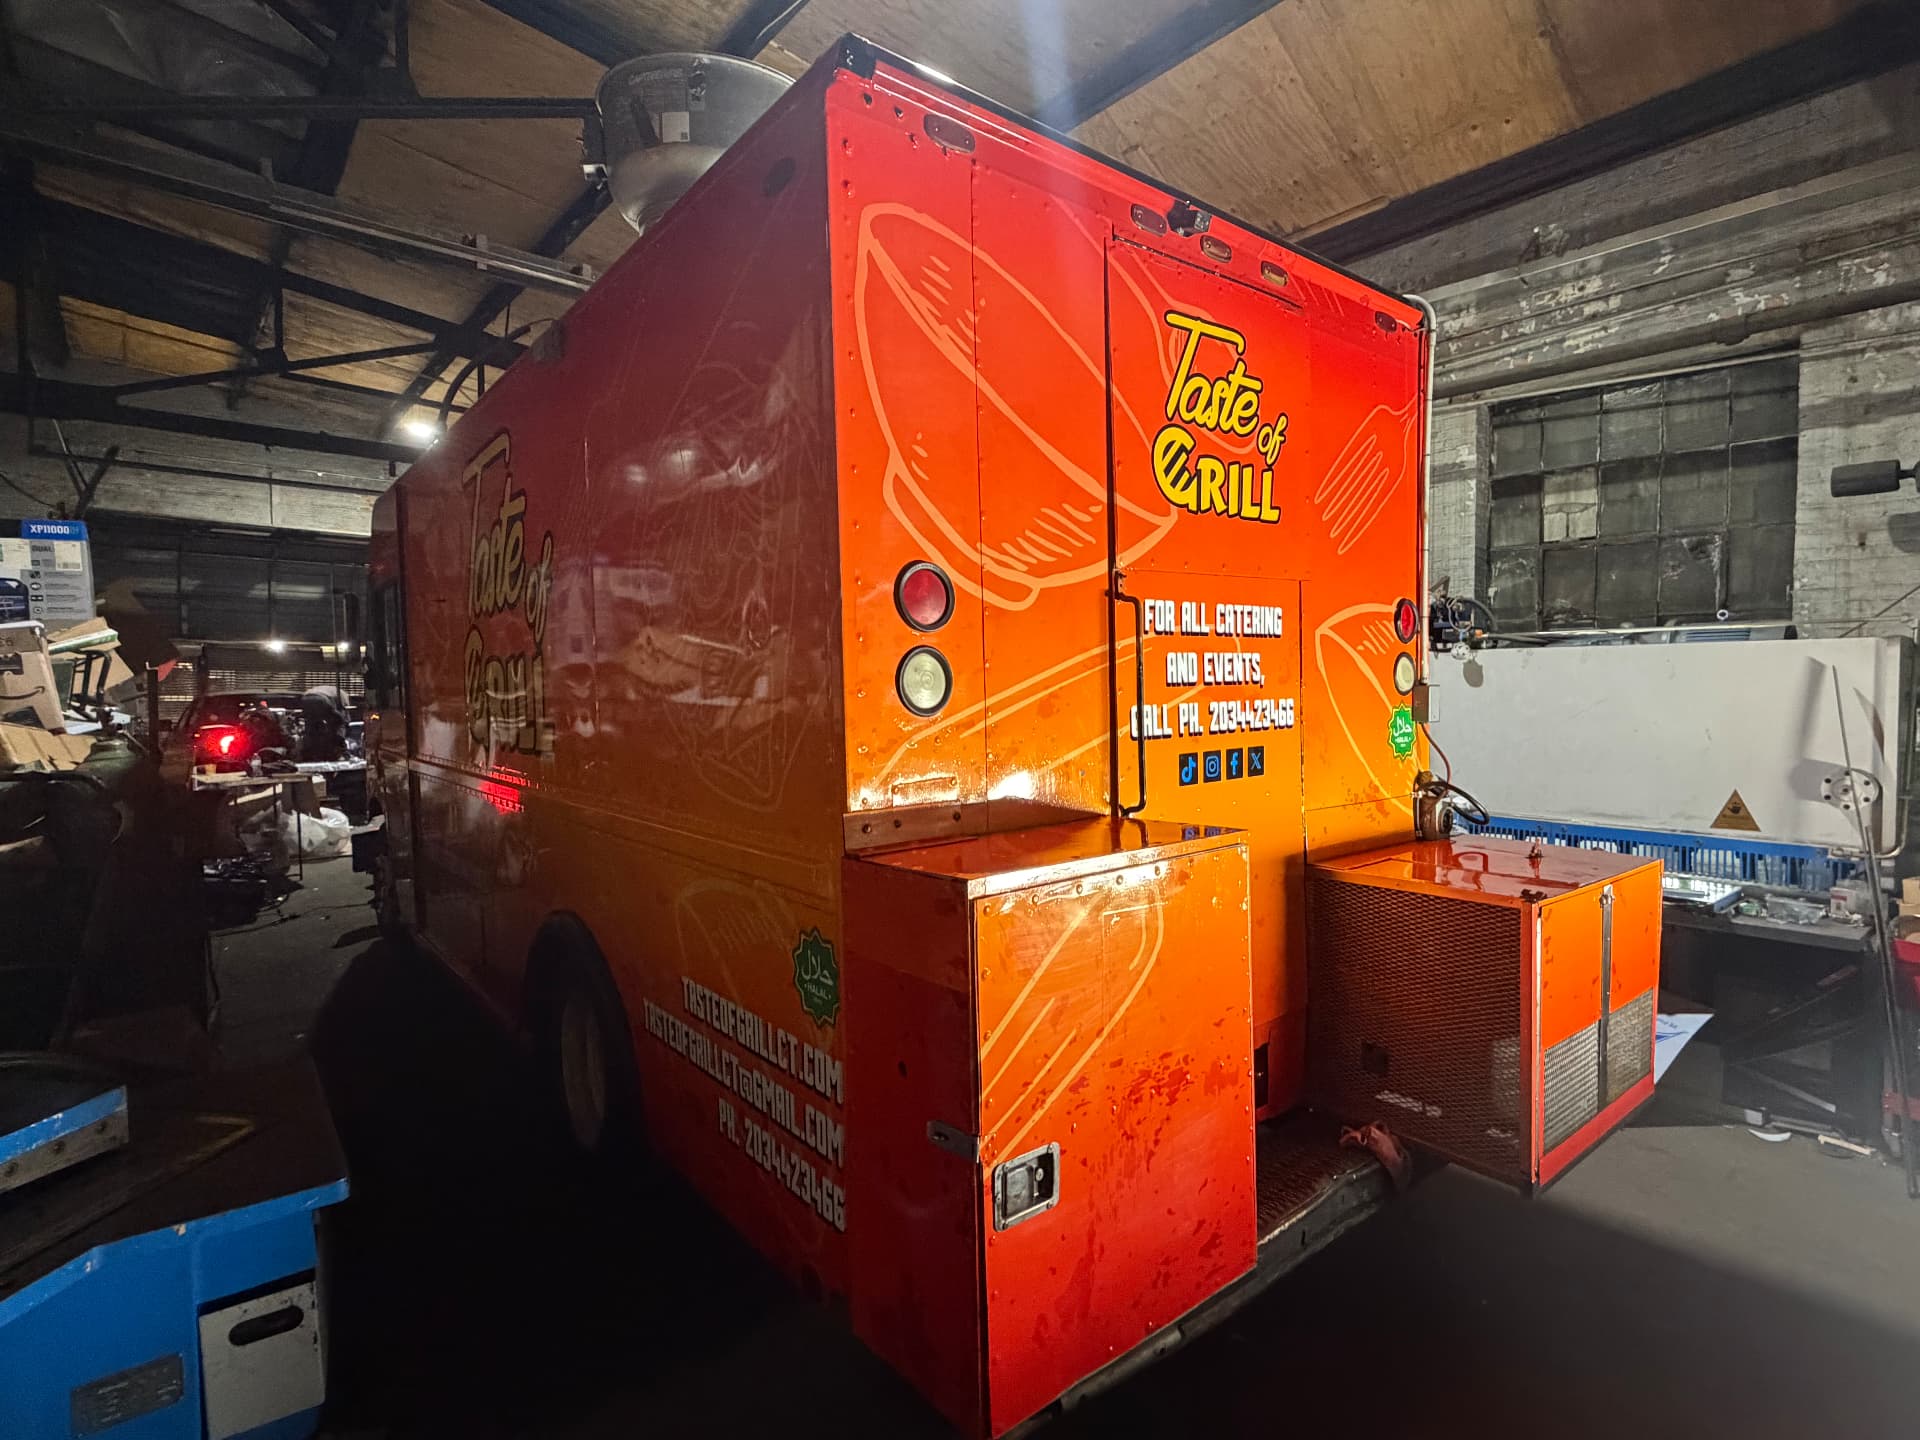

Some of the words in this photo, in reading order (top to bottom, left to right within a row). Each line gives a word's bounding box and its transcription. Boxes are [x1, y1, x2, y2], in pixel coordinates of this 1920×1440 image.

[1165, 310, 1263, 436] Taste
[1153, 424, 1281, 524] GRILL
[1257, 413, 1288, 466] of
[462, 428, 527, 620] Taste
[526, 530, 552, 652] of
[1144, 599, 1175, 634] FOR
[1181, 602, 1210, 635] ALL
[1215, 603, 1282, 638] CATERING
[1130, 703, 1173, 740] CALL
[1179, 702, 1204, 737] PH.
[1208, 698, 1294, 734] 2034423466
[1166, 652, 1198, 687] AND
[1203, 652, 1265, 688] EVENTS,
[801, 949, 834, 986] حلال
[643, 997, 845, 1169] TASTEOFGRILLCT@GMAIL.COM
[681, 975, 844, 1105] TASTEOFGRILLCT.COM
[718, 1098, 741, 1147] PH.
[744, 1117, 846, 1232] 2034423466
